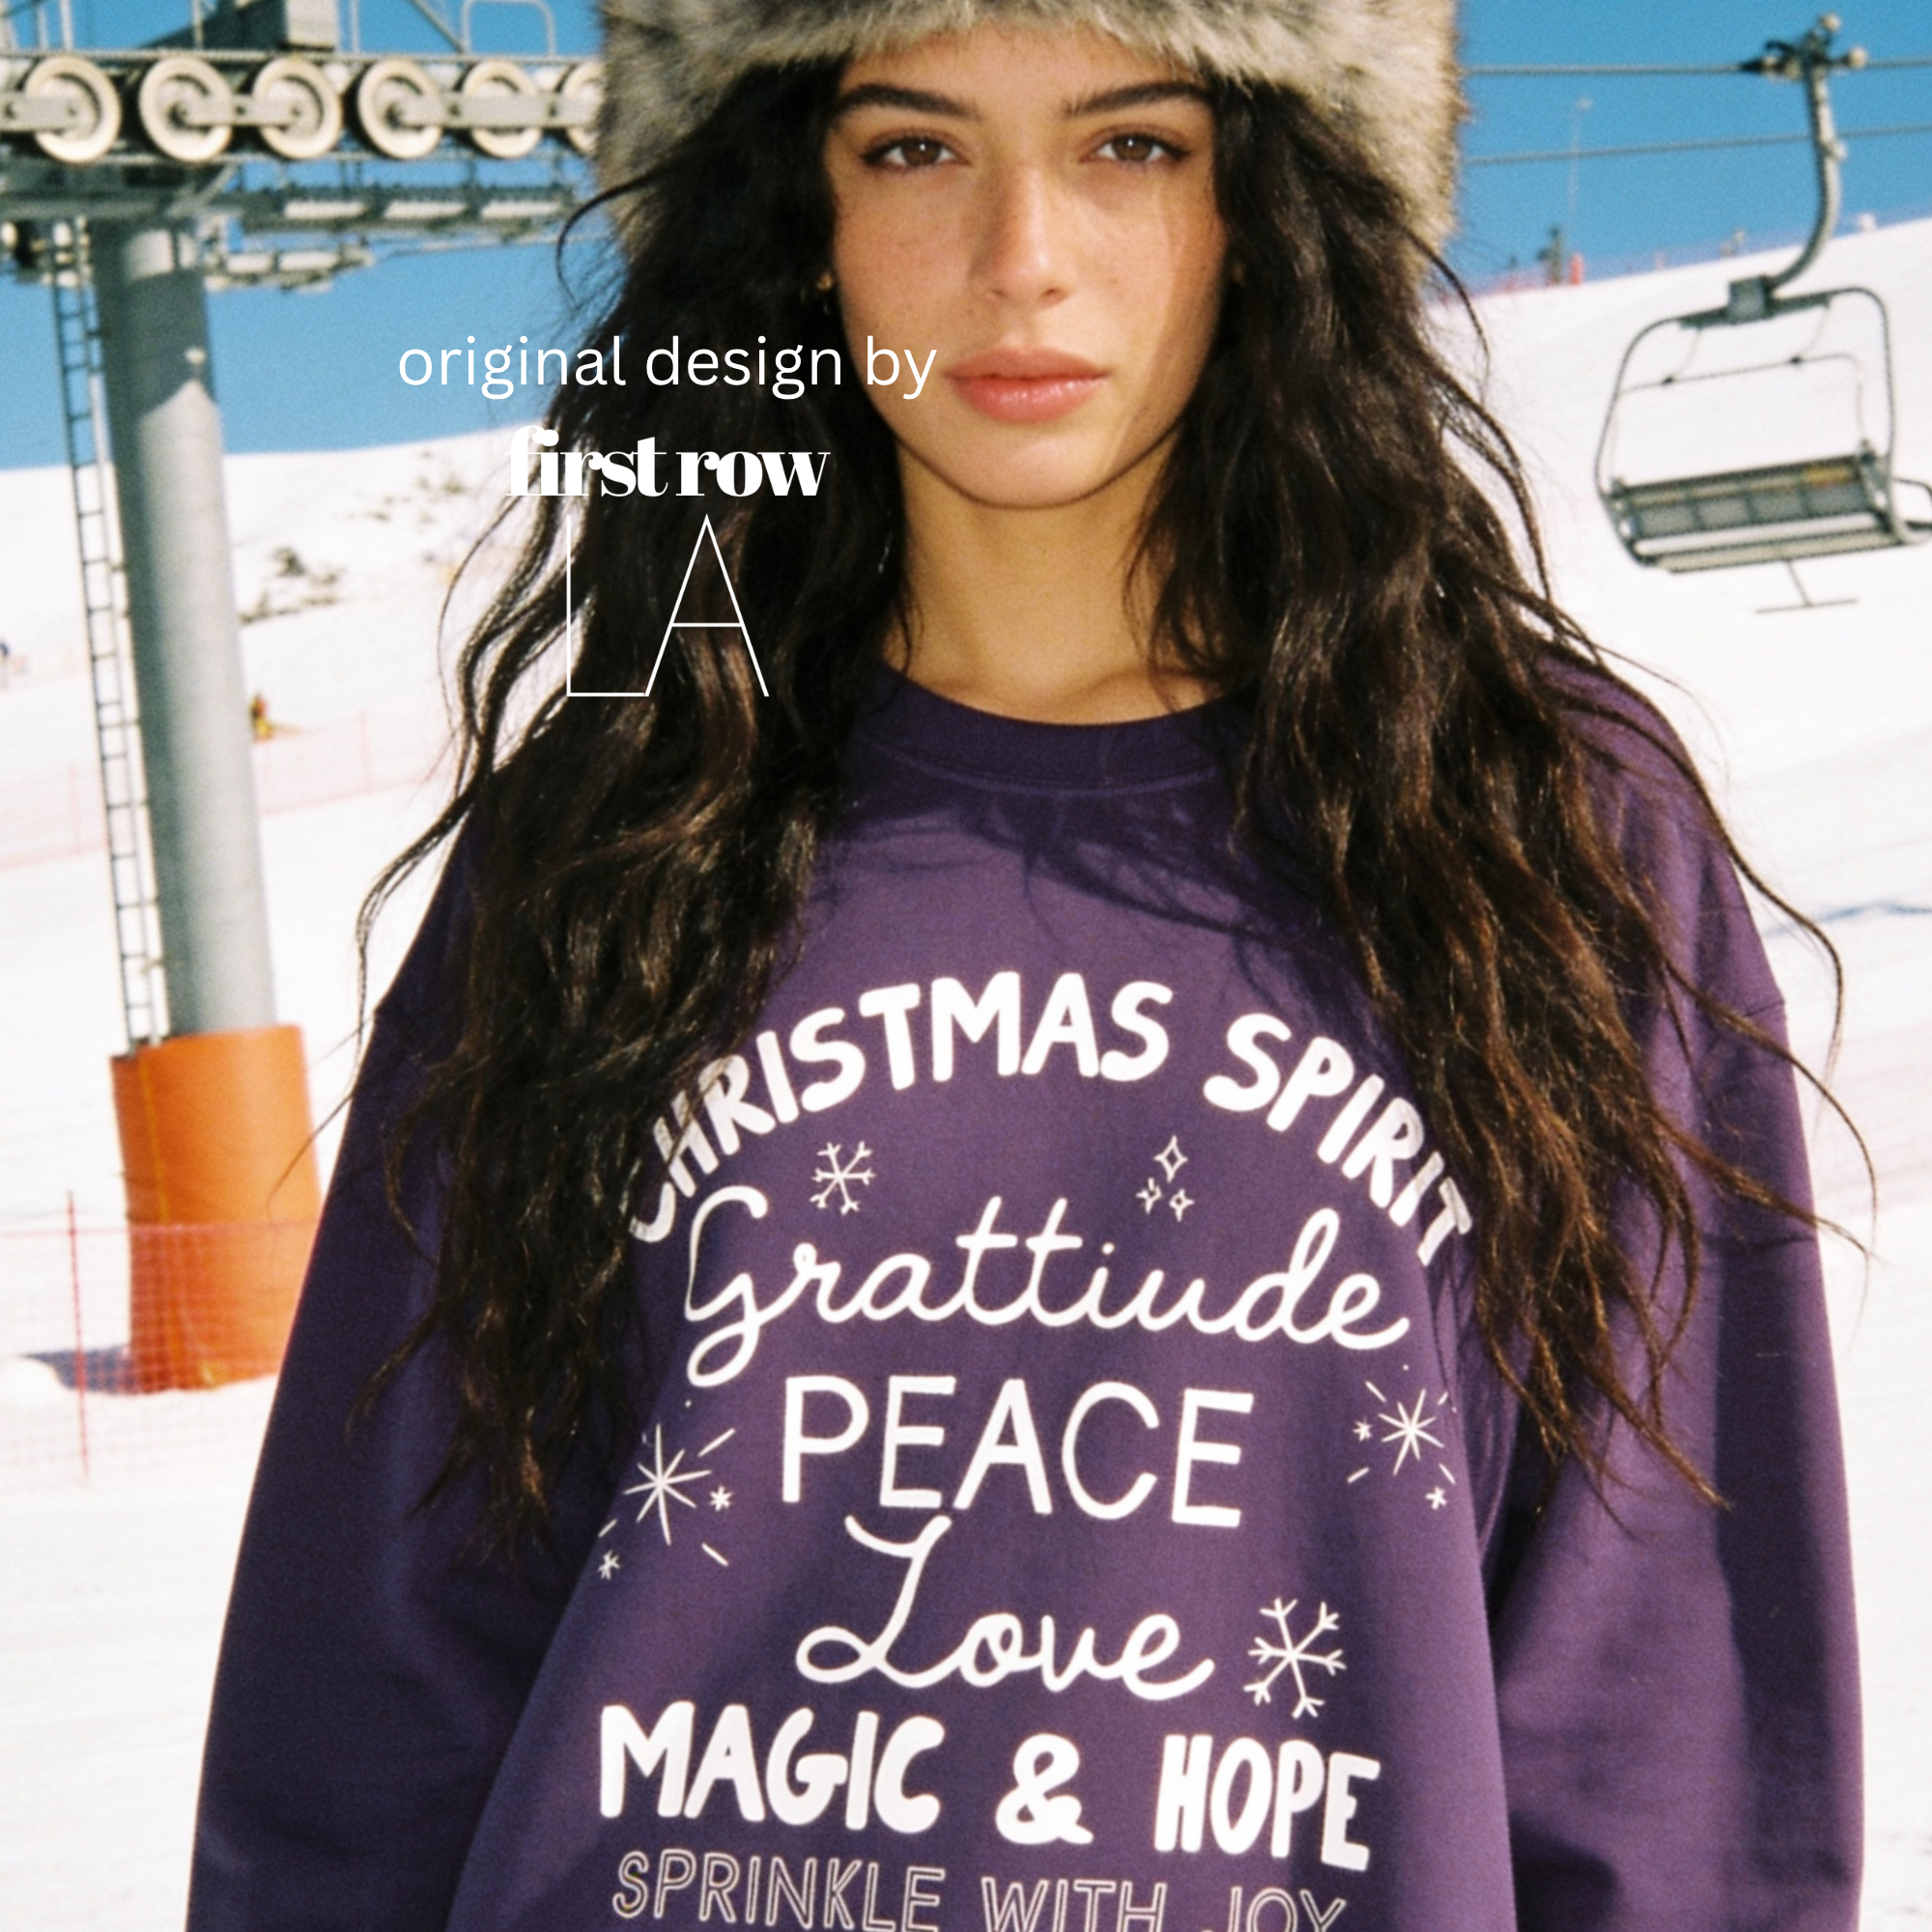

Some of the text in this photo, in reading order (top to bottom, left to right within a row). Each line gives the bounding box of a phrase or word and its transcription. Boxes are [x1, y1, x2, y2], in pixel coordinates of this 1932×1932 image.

[1203, 1012, 1472, 1267] SPIRIT
[684, 1184, 1410, 1388] Grattiude
[781, 1375, 1255, 1529] PEACE
[795, 1514, 1215, 1702] Love
[599, 1700, 1381, 1872] MAGIC & HOPE
[611, 1848, 1347, 1932] SPRINKLE WITH JOY
